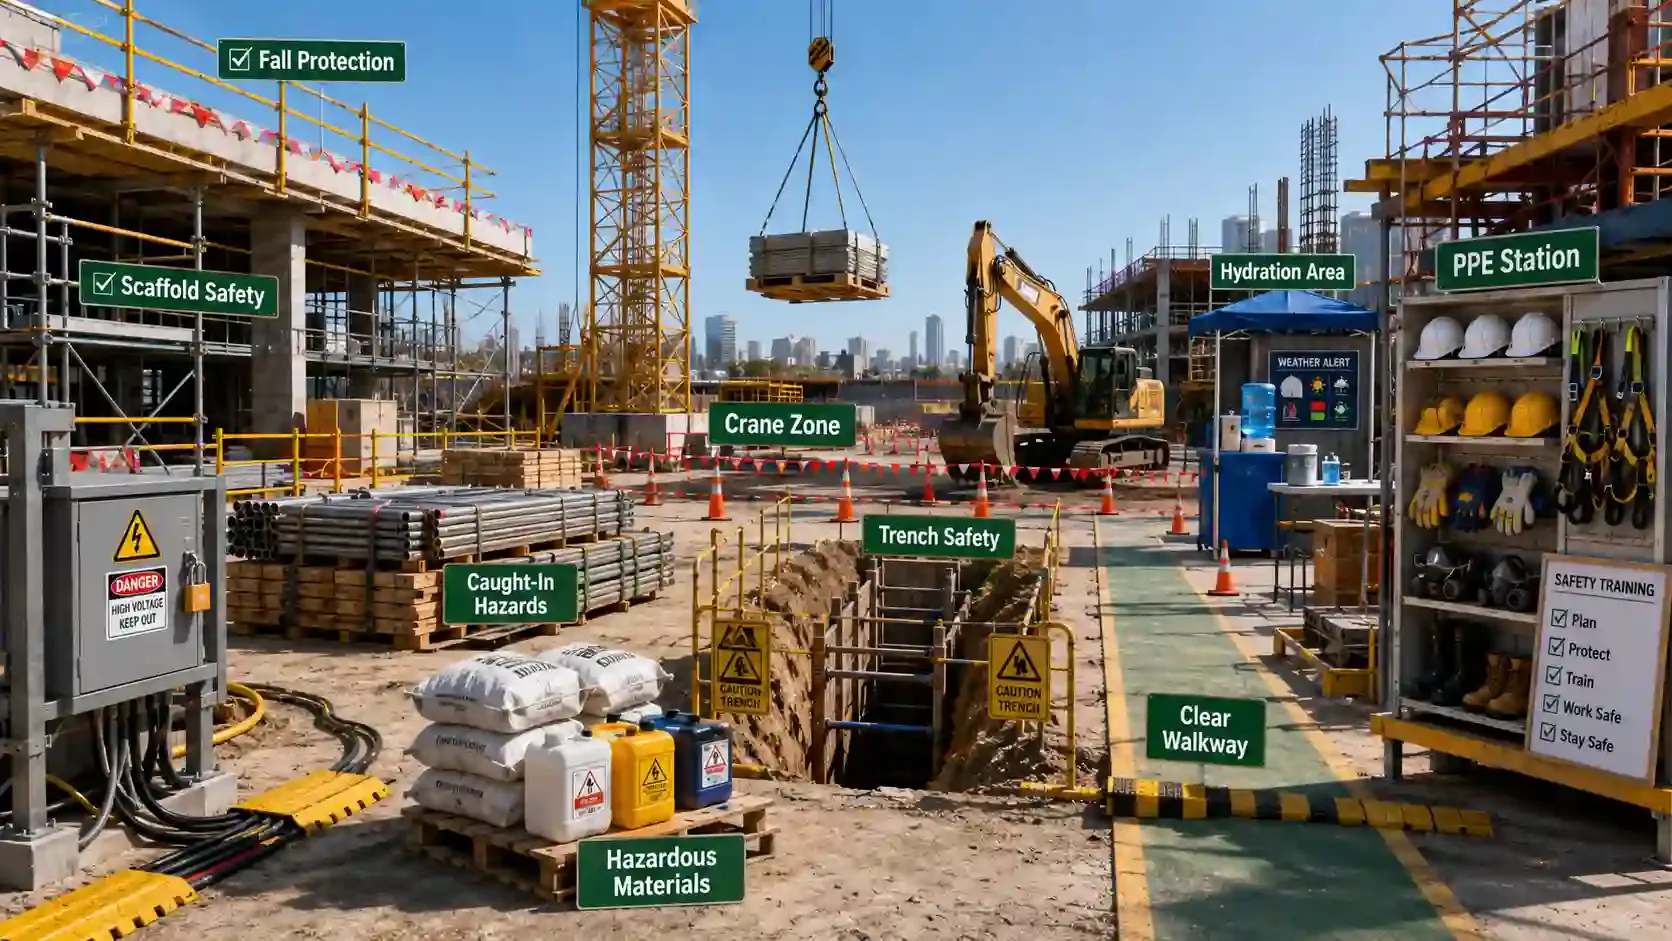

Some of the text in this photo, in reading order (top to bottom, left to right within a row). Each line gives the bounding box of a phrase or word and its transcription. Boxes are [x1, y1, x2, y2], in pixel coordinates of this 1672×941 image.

[259, 50, 394, 73] Fall Protection
[1453, 243, 1580, 277] PPE Station
[1221, 262, 1345, 284] Hydration Area
[121, 275, 265, 310] Scaffold Safety
[1278, 357, 1350, 368] WEATHER ALERT
[725, 413, 841, 436] Crane Zone
[878, 526, 1001, 553] Trench Safety
[116, 575, 159, 593] DANGER
[467, 572, 554, 595] Caught-In
[1554, 573, 1655, 597] SAFETY TRAINING
[111, 597, 164, 615] HIGH VOLTAGE
[474, 594, 548, 616] Hazards
[119, 612, 157, 630] KEEP OUT
[1571, 613, 1597, 629] Plan
[1568, 642, 1611, 661] Protect
[996, 684, 1042, 699] CAUTION
[1566, 671, 1595, 689] Train
[998, 700, 1040, 714] TRENCH
[1180, 704, 1232, 728] Clear
[1563, 700, 1622, 724] Work Safe
[1161, 731, 1249, 759] Walkway
[1559, 728, 1615, 753] Stay Safe
[607, 846, 717, 871] Hazardous
[613, 872, 711, 897] Materials
